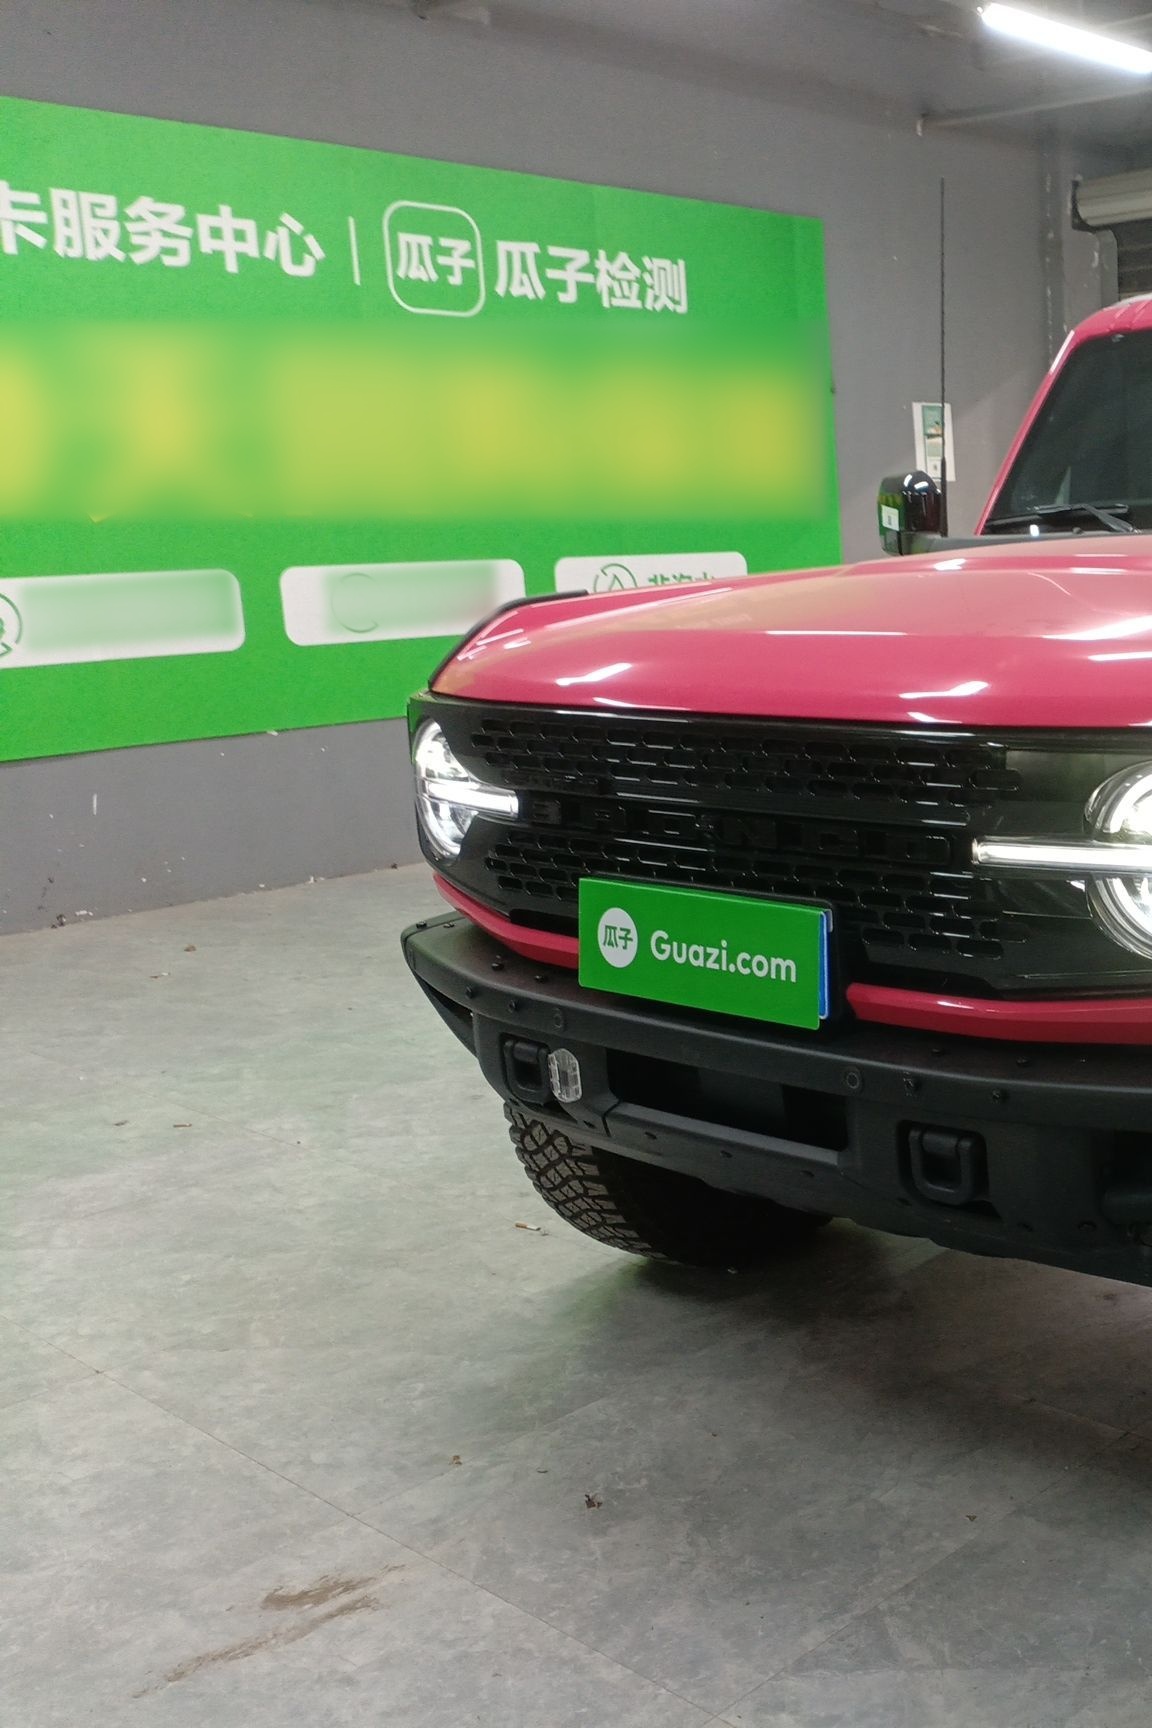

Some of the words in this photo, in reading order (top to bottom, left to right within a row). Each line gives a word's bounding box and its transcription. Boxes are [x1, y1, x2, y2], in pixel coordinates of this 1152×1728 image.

[0, 179, 326, 277] 卡服务中心
[396, 232, 476, 286] 瓜子
[494, 240, 689, 314] 瓜子检测
[603, 924, 634, 951] 瓜子
[650, 929, 797, 983] Guazi.com
